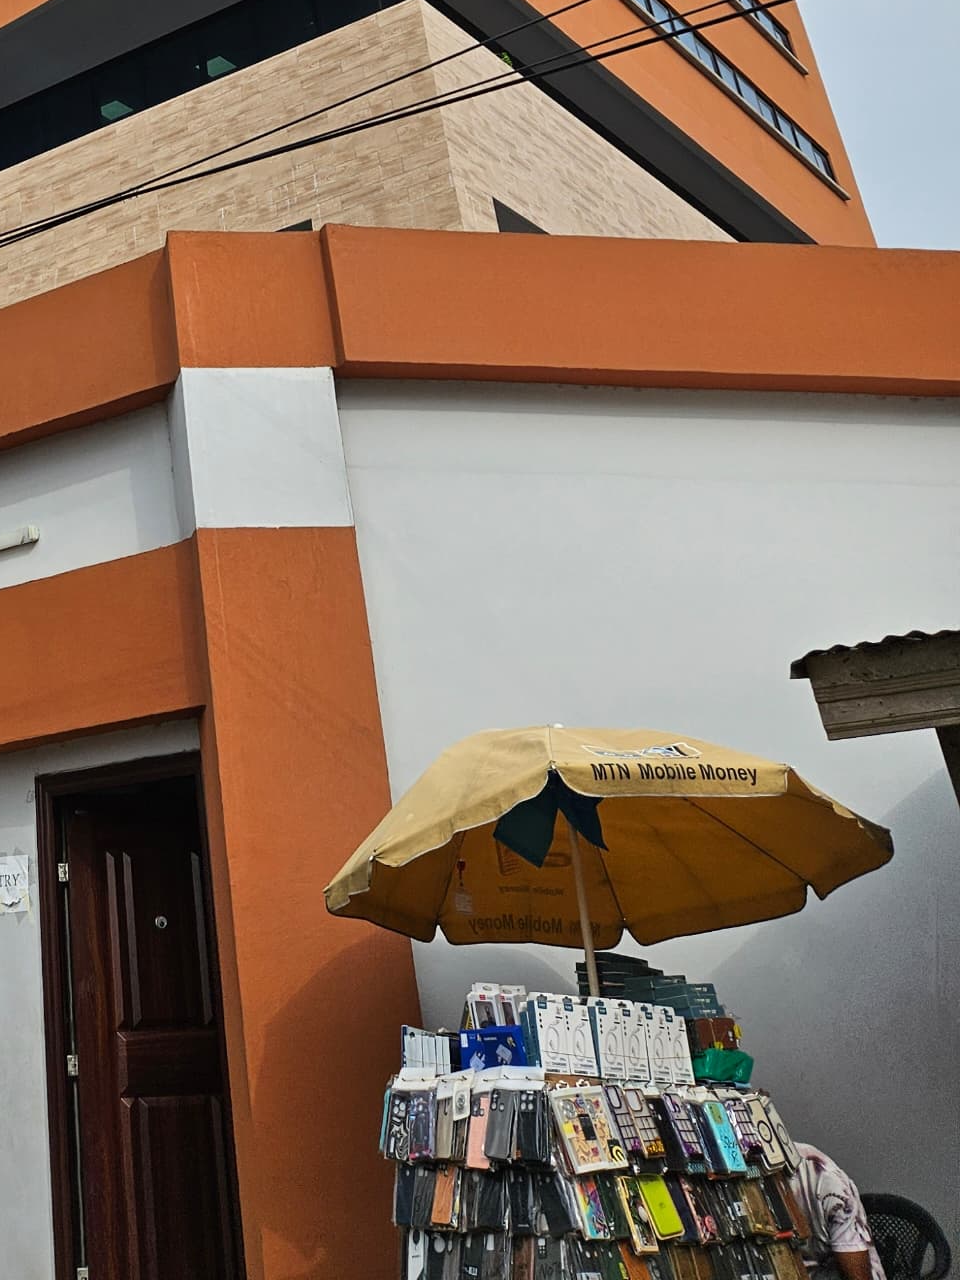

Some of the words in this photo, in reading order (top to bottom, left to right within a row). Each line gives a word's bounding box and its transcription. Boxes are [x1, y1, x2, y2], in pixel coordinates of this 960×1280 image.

[590, 763, 631, 781] MTN
[637, 763, 696, 781] Mobile
[698, 763, 757, 786] Money
